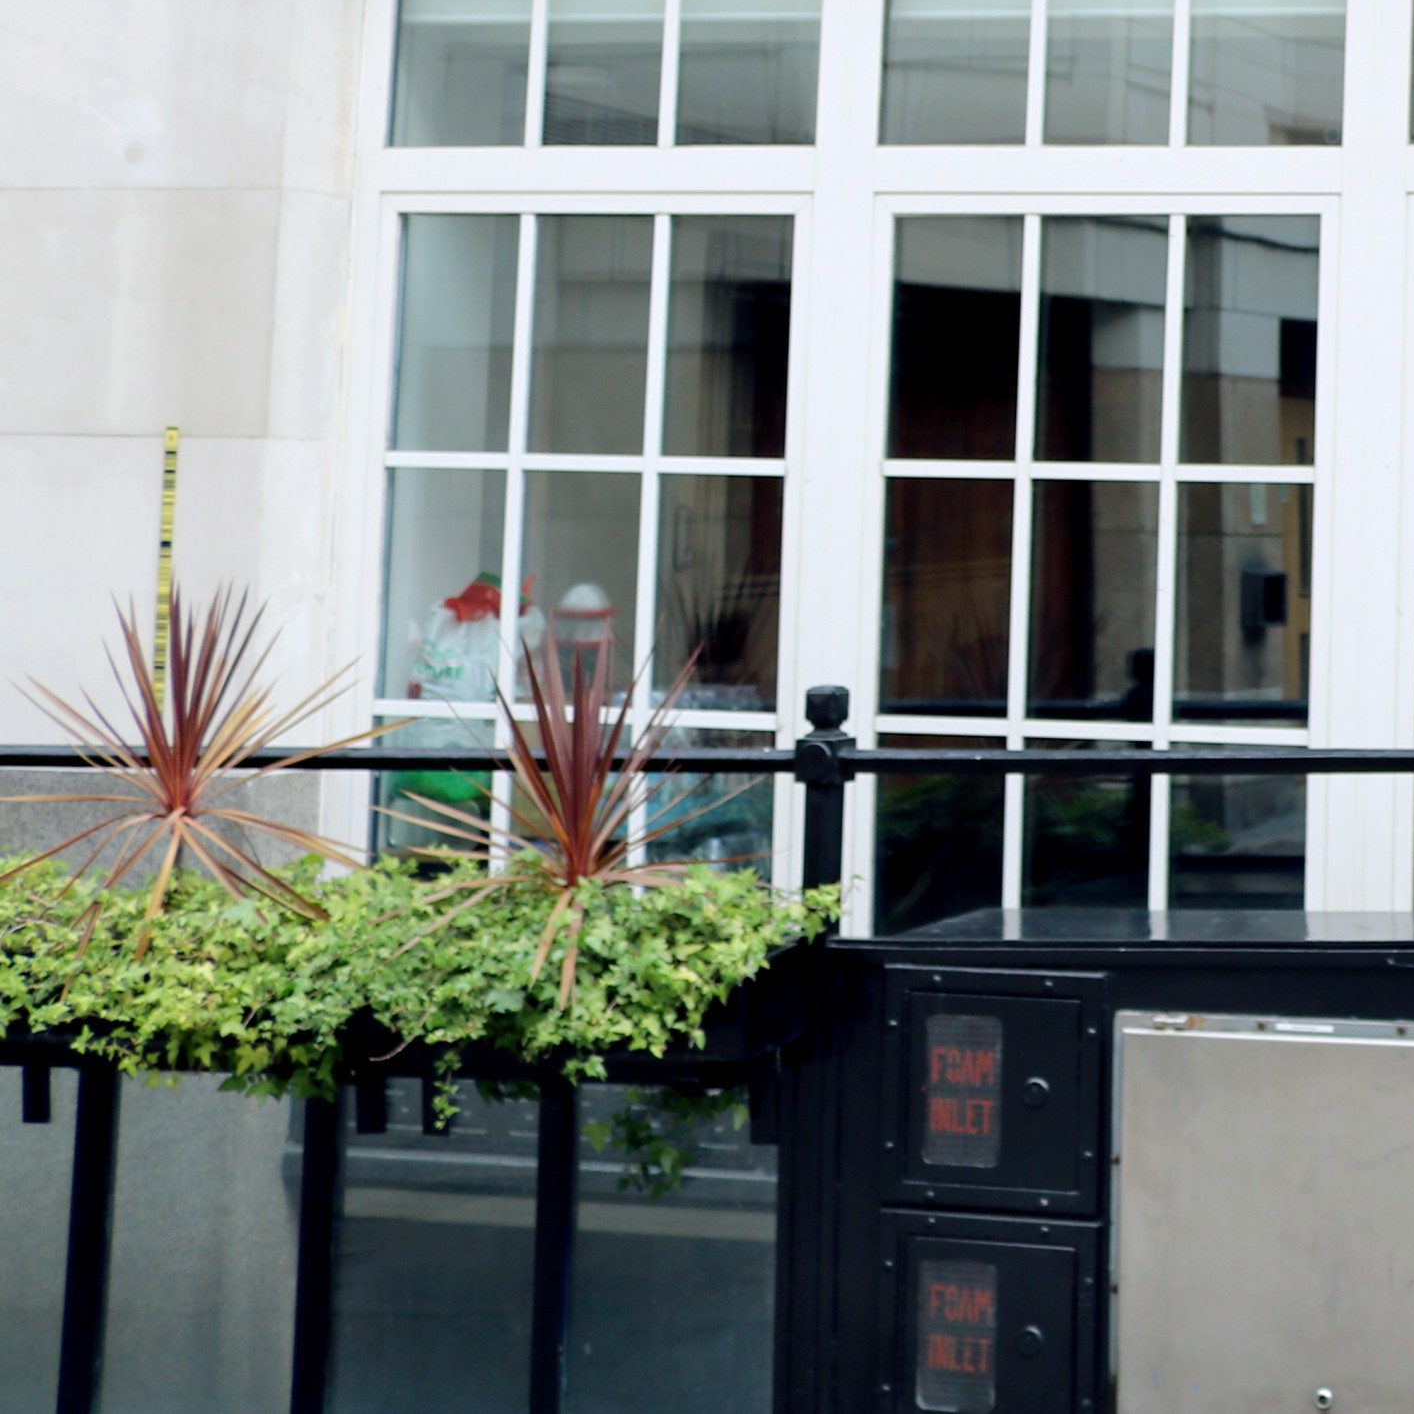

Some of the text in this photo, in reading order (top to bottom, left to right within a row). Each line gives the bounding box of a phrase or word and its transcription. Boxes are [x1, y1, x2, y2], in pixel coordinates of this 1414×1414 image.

[929, 1046, 997, 1086] FOAM
[929, 1097, 996, 1135] INLET
[926, 1333, 992, 1374] INLET
